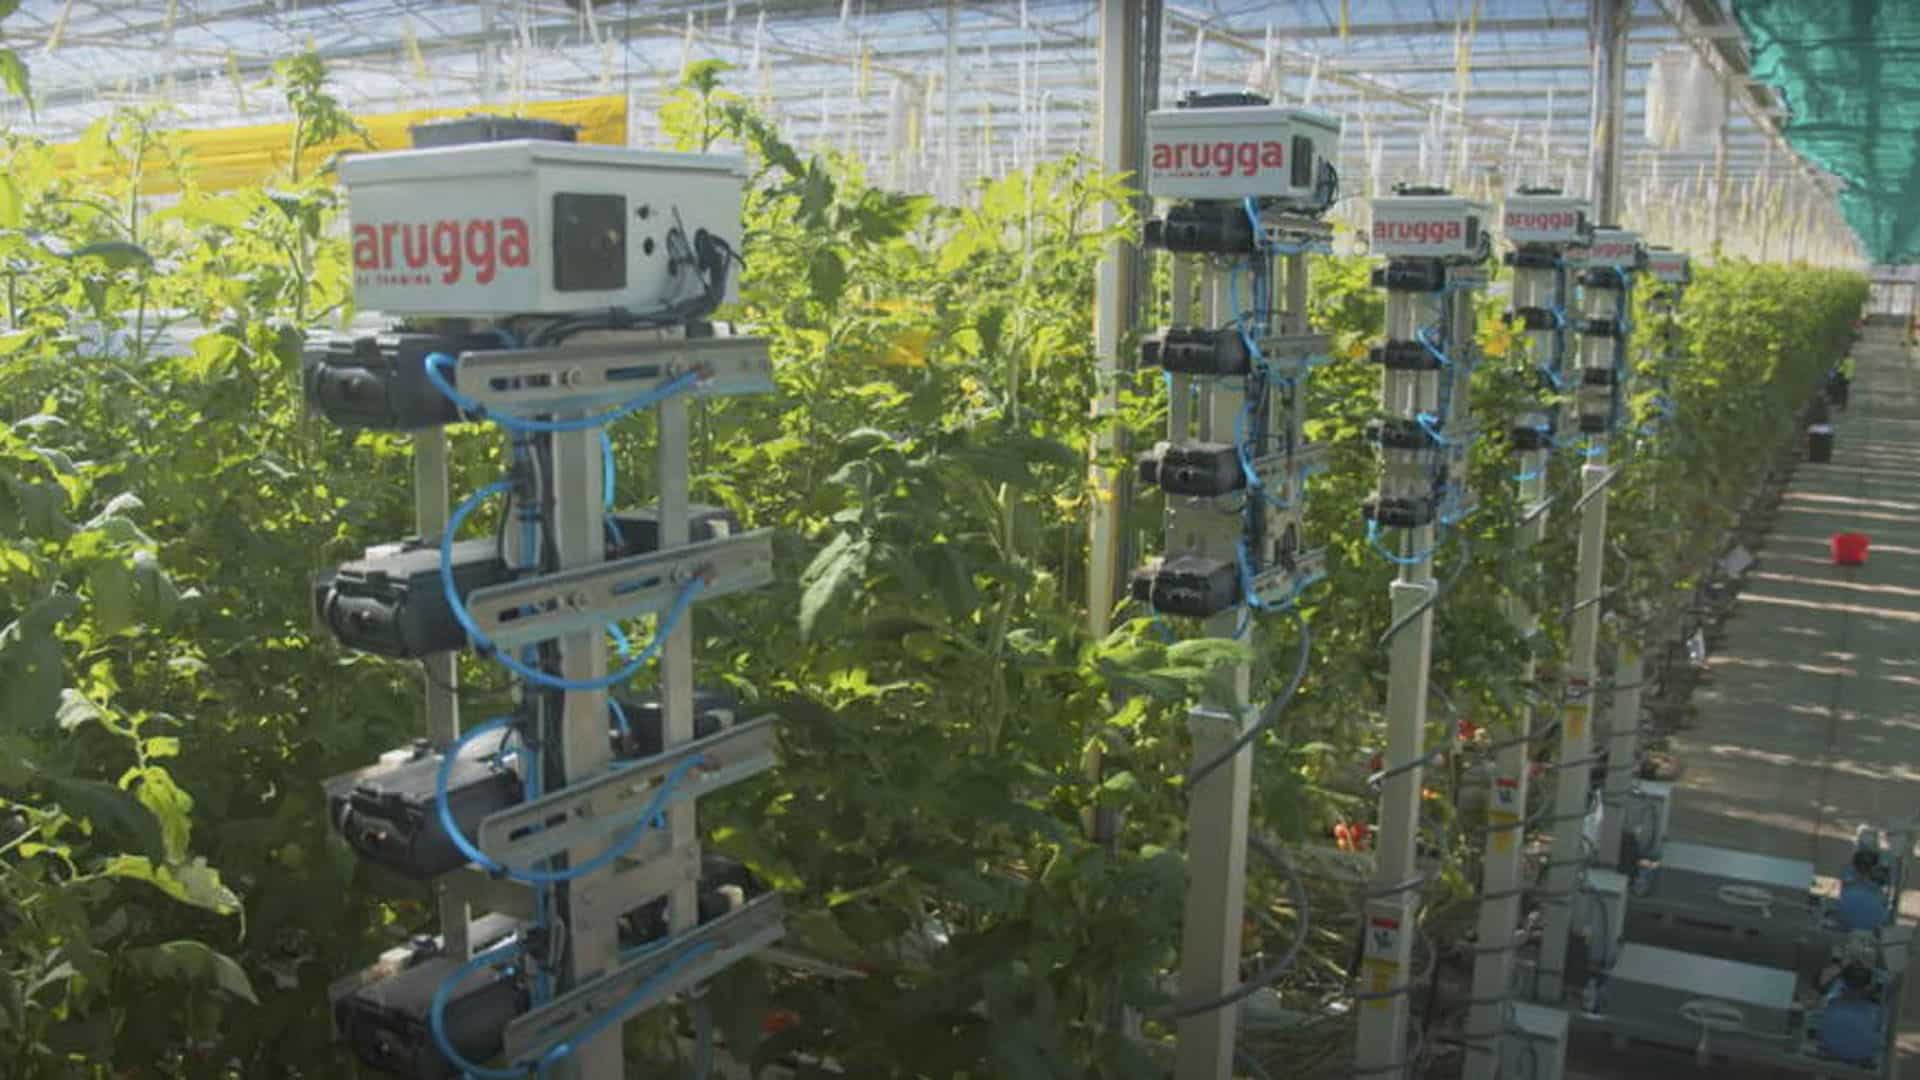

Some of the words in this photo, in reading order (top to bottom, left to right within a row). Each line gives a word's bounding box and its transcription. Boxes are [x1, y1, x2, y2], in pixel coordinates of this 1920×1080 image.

[1152, 140, 1283, 176] arugga
[1374, 221, 1460, 244] arugga
[353, 217, 530, 285] arugga
